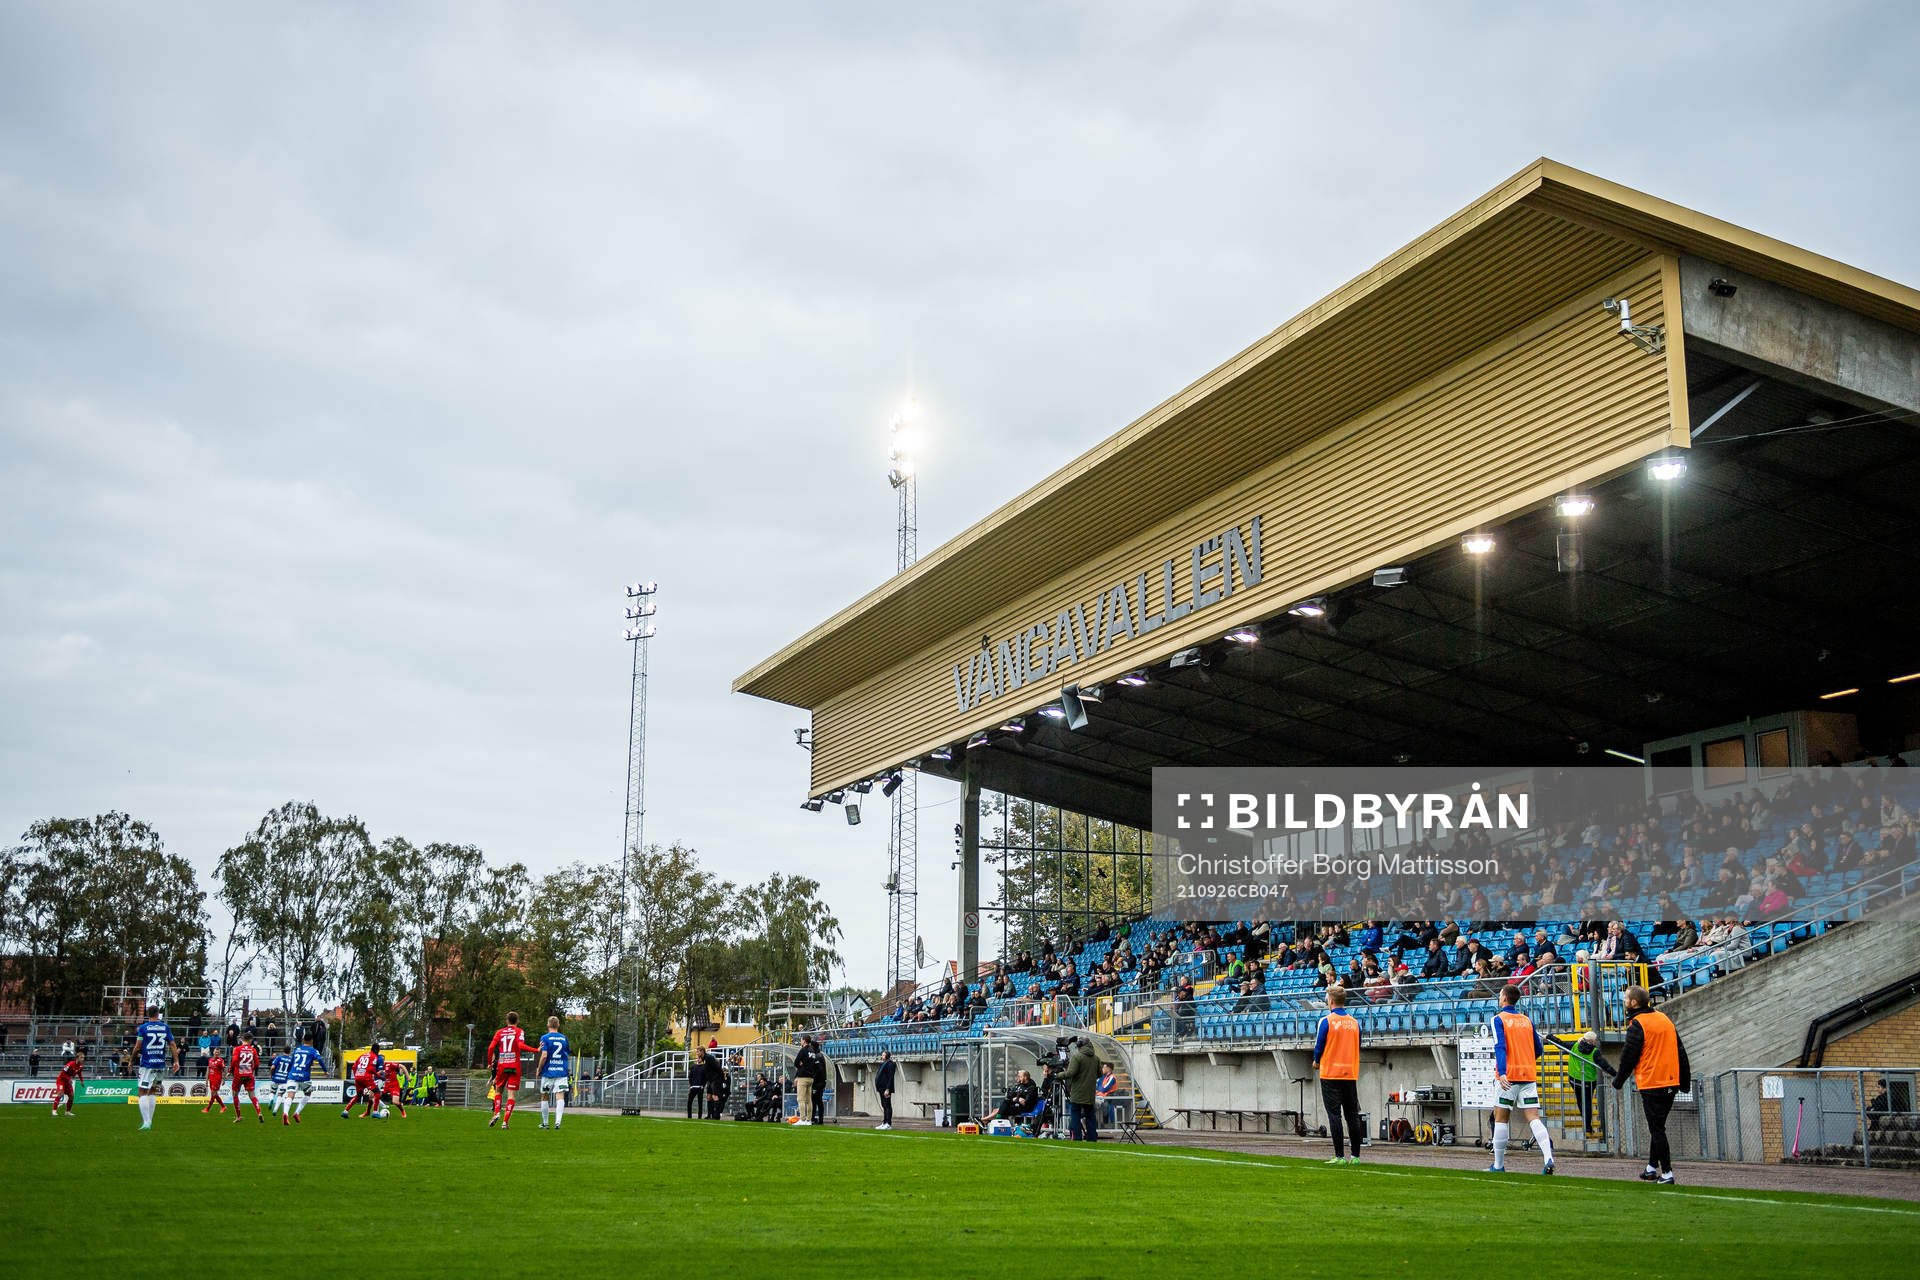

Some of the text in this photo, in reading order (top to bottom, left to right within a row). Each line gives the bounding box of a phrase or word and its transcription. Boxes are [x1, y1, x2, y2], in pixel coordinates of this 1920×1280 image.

[952, 515, 1262, 714] VÅNGAVALLEN
[146, 1032, 167, 1050] 23
[501, 1035, 515, 1052] 17
[552, 1042, 562, 1058] 2
[239, 1052, 254, 1066] 22
[294, 1054, 308, 1068] 21
[278, 1062, 290, 1074] 11
[85, 1086, 132, 1096] Europcar
